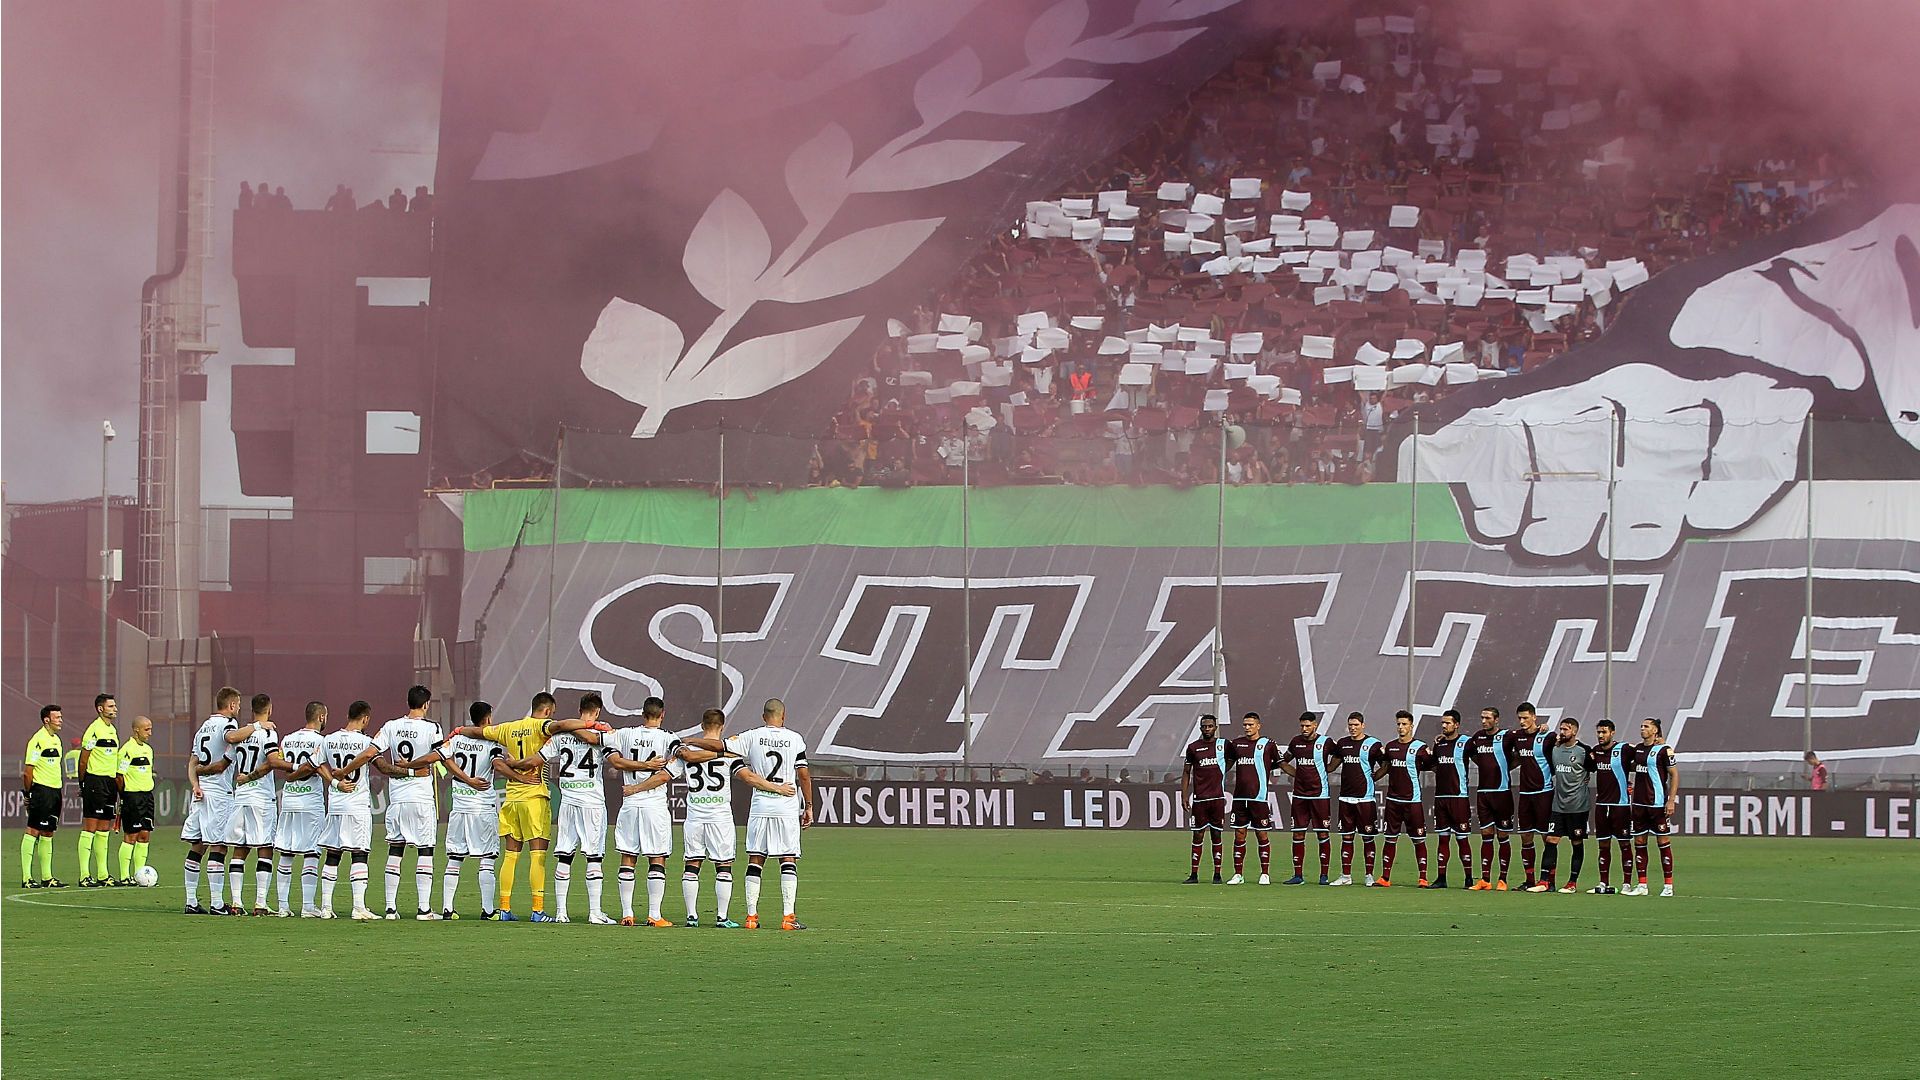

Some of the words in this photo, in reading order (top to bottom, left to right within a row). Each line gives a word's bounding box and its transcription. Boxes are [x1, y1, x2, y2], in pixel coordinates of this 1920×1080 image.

[396, 729, 418, 739] MOREO
[634, 738, 653, 748] SALVI
[759, 737, 791, 748] BELLUSCI
[201, 735, 212, 766] 5
[397, 740, 414, 763] 9
[517, 740, 524, 760] 1
[560, 747, 599, 779] 24
[686, 760, 725, 793] 35
[766, 750, 784, 783] 2
[812, 786, 1015, 827] XISCHERMI
[1064, 789, 1131, 828] LED
[1866, 797, 1919, 838] LE
